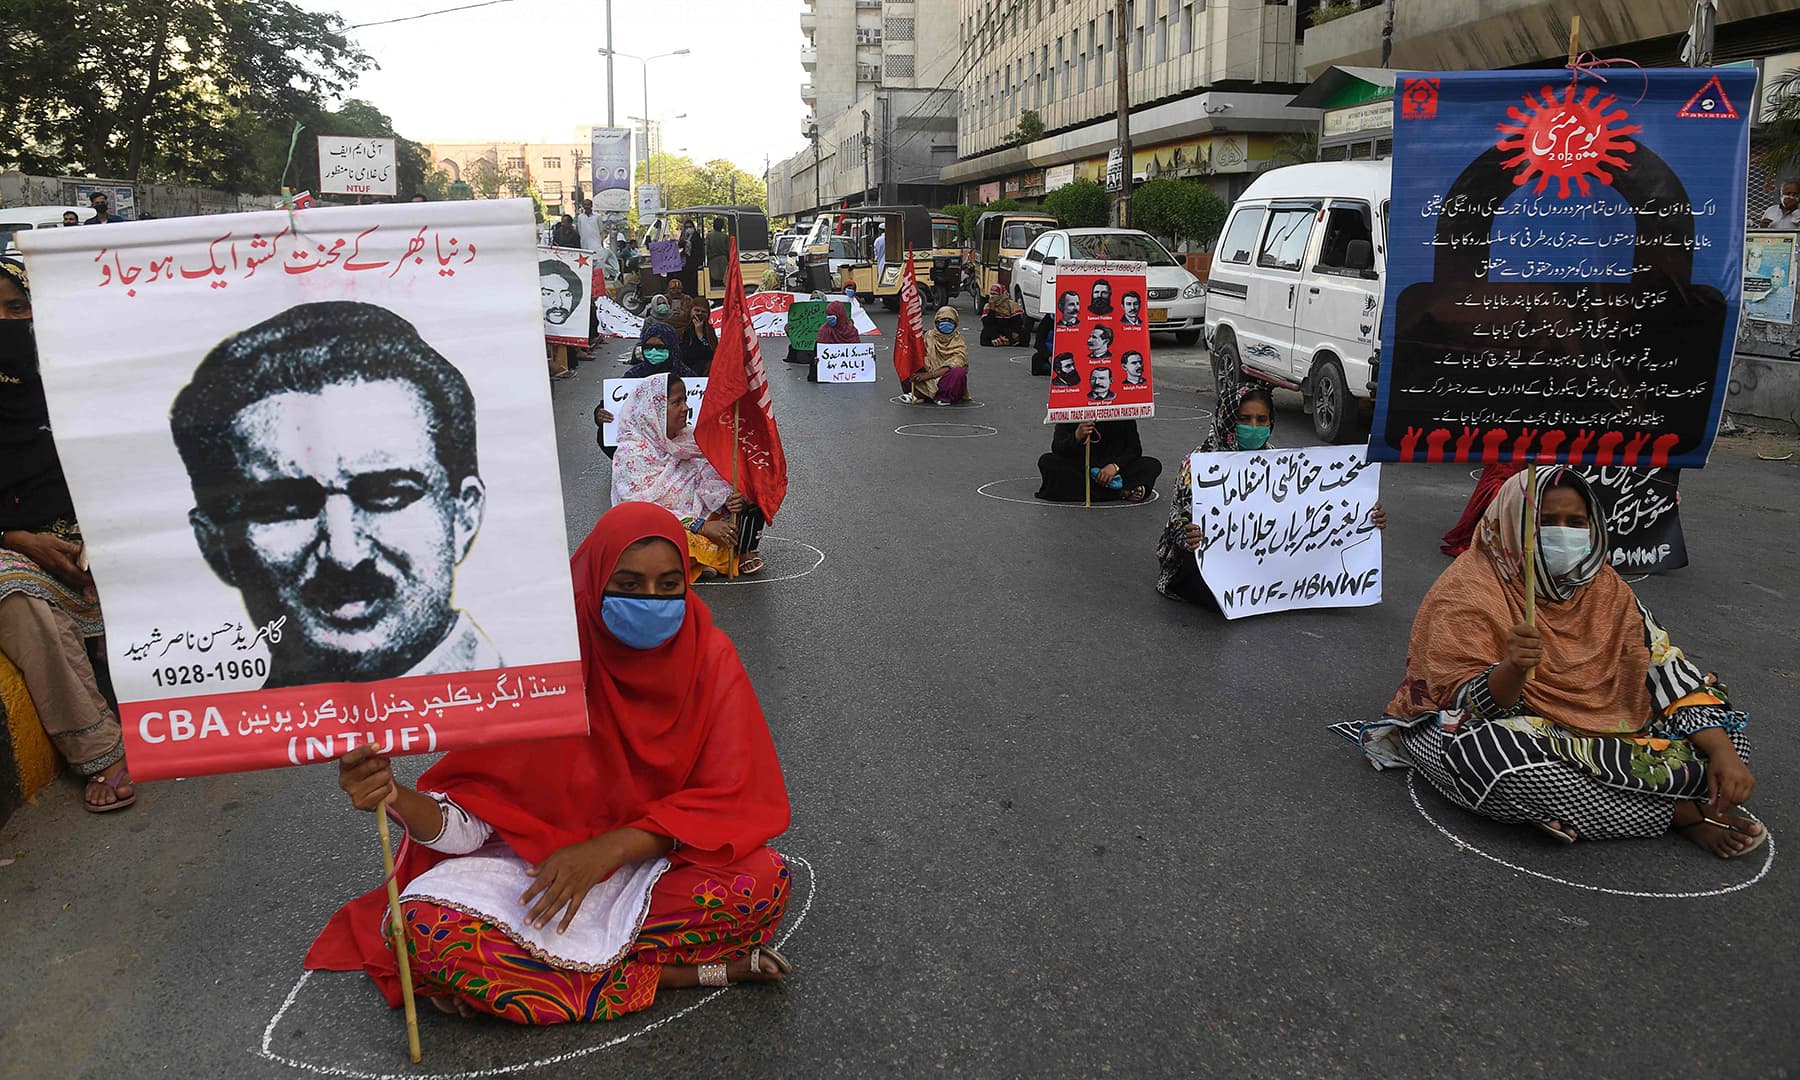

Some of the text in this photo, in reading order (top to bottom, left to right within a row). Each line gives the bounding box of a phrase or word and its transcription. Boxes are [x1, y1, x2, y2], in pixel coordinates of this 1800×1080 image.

[1532, 111, 1577, 156] مئی
[330, 140, 384, 159] آئی ایم ایف
[1548, 152, 1584, 161] 2020
[355, 167, 378, 181] غلامی
[378, 164, 391, 182] کی
[346, 184, 371, 193] NTUF
[1421, 194, 1443, 217] یقینی
[1439, 198, 1454, 215] کو
[1448, 194, 1480, 217] ادائیگی
[1481, 196, 1498, 217] کی
[1527, 196, 1543, 217] کی
[1538, 203, 1585, 218] مزدوروں
[1582, 200, 1606, 220] تمام
[1603, 203, 1640, 217] دوران
[1638, 198, 1657, 215] کے
[1658, 202, 1690, 217] ڈاؤن
[1691, 198, 1716, 216] لاک
[1462, 231, 1480, 246] روکا
[1479, 229, 1509, 245] سلسلہ
[1509, 231, 1521, 246] کا
[1520, 227, 1553, 248] برطرفی
[1553, 232, 1578, 248] جبری
[1577, 236, 1597, 245] سے
[1598, 233, 1647, 248] ملازمتوں
[1645, 234, 1663, 247] اور
[1663, 233, 1694, 250] جائے
[1694, 234, 1712, 250] بنایا
[343, 224, 391, 271] کے
[388, 224, 429, 279] بھر
[435, 232, 477, 278] دنیا
[180, 231, 238, 290] ایک
[284, 238, 346, 276] محنت
[1573, 258, 1588, 273] کو
[94, 247, 143, 298] جاؤ
[145, 254, 174, 283] ہو
[1474, 257, 1507, 279] متعلق
[1500, 268, 1520, 276] سے
[1521, 260, 1552, 279] حقوق
[1548, 265, 1577, 279] مزدور
[1613, 264, 1653, 277] صنعت
[1492, 294, 1510, 310] بنایا
[1511, 294, 1532, 312] پابند
[1534, 292, 1545, 306] کا
[1567, 286, 1588, 309] عمل
[1590, 293, 1634, 307] احکامات
[1634, 290, 1669, 310] حکومتی
[1473, 316, 1643, 342] تمام غیر ملکی قرضوں کو منسوخ کیا جائے
[821, 347, 849, 360] Social
[1472, 350, 1490, 368] کیا
[1486, 351, 1511, 368] خرچ
[1507, 349, 1528, 369] لیے
[1527, 350, 1545, 366] کے
[1576, 353, 1601, 368] فلاح
[1601, 349, 1617, 369] کی
[1611, 353, 1637, 372] عوام
[1660, 356, 1679, 368] اور
[840, 359, 865, 372] ALL!
[833, 371, 858, 381] NTUF
[1467, 385, 1486, 394] سے
[1487, 383, 1525, 396] اداروں
[1523, 379, 1541, 394] کے
[1576, 376, 1605, 398] سوشل
[1603, 378, 1617, 396] کو
[1610, 380, 1648, 400] شہریوں
[1643, 383, 1668, 400] تمام
[1665, 380, 1708, 398] حکومت
[1470, 407, 1489, 425] کیا
[1481, 411, 1504, 424] برابر
[1503, 408, 1521, 423] کے
[1523, 411, 1548, 426] بجٹ
[1547, 409, 1576, 426] دفاعی
[1575, 411, 1601, 426] بجٹ
[1600, 411, 1612, 425] کا
[1606, 405, 1634, 430] تعلیم
[1197, 451, 1373, 506] سخت حفاظتی انتظامات
[1267, 499, 1334, 557] فیکٹریاں
[1316, 499, 1360, 550] بغیر
[1355, 506, 1377, 534] کے
[122, 613, 288, 661] کامریڈ حسن ناصر شہید
[152, 657, 267, 688] 1928-1960
[297, 698, 361, 729] ورکرز
[363, 691, 416, 724] جنرل
[138, 706, 230, 744] CBA
[237, 709, 293, 738] یونین
[287, 722, 438, 765] (NTUF)
